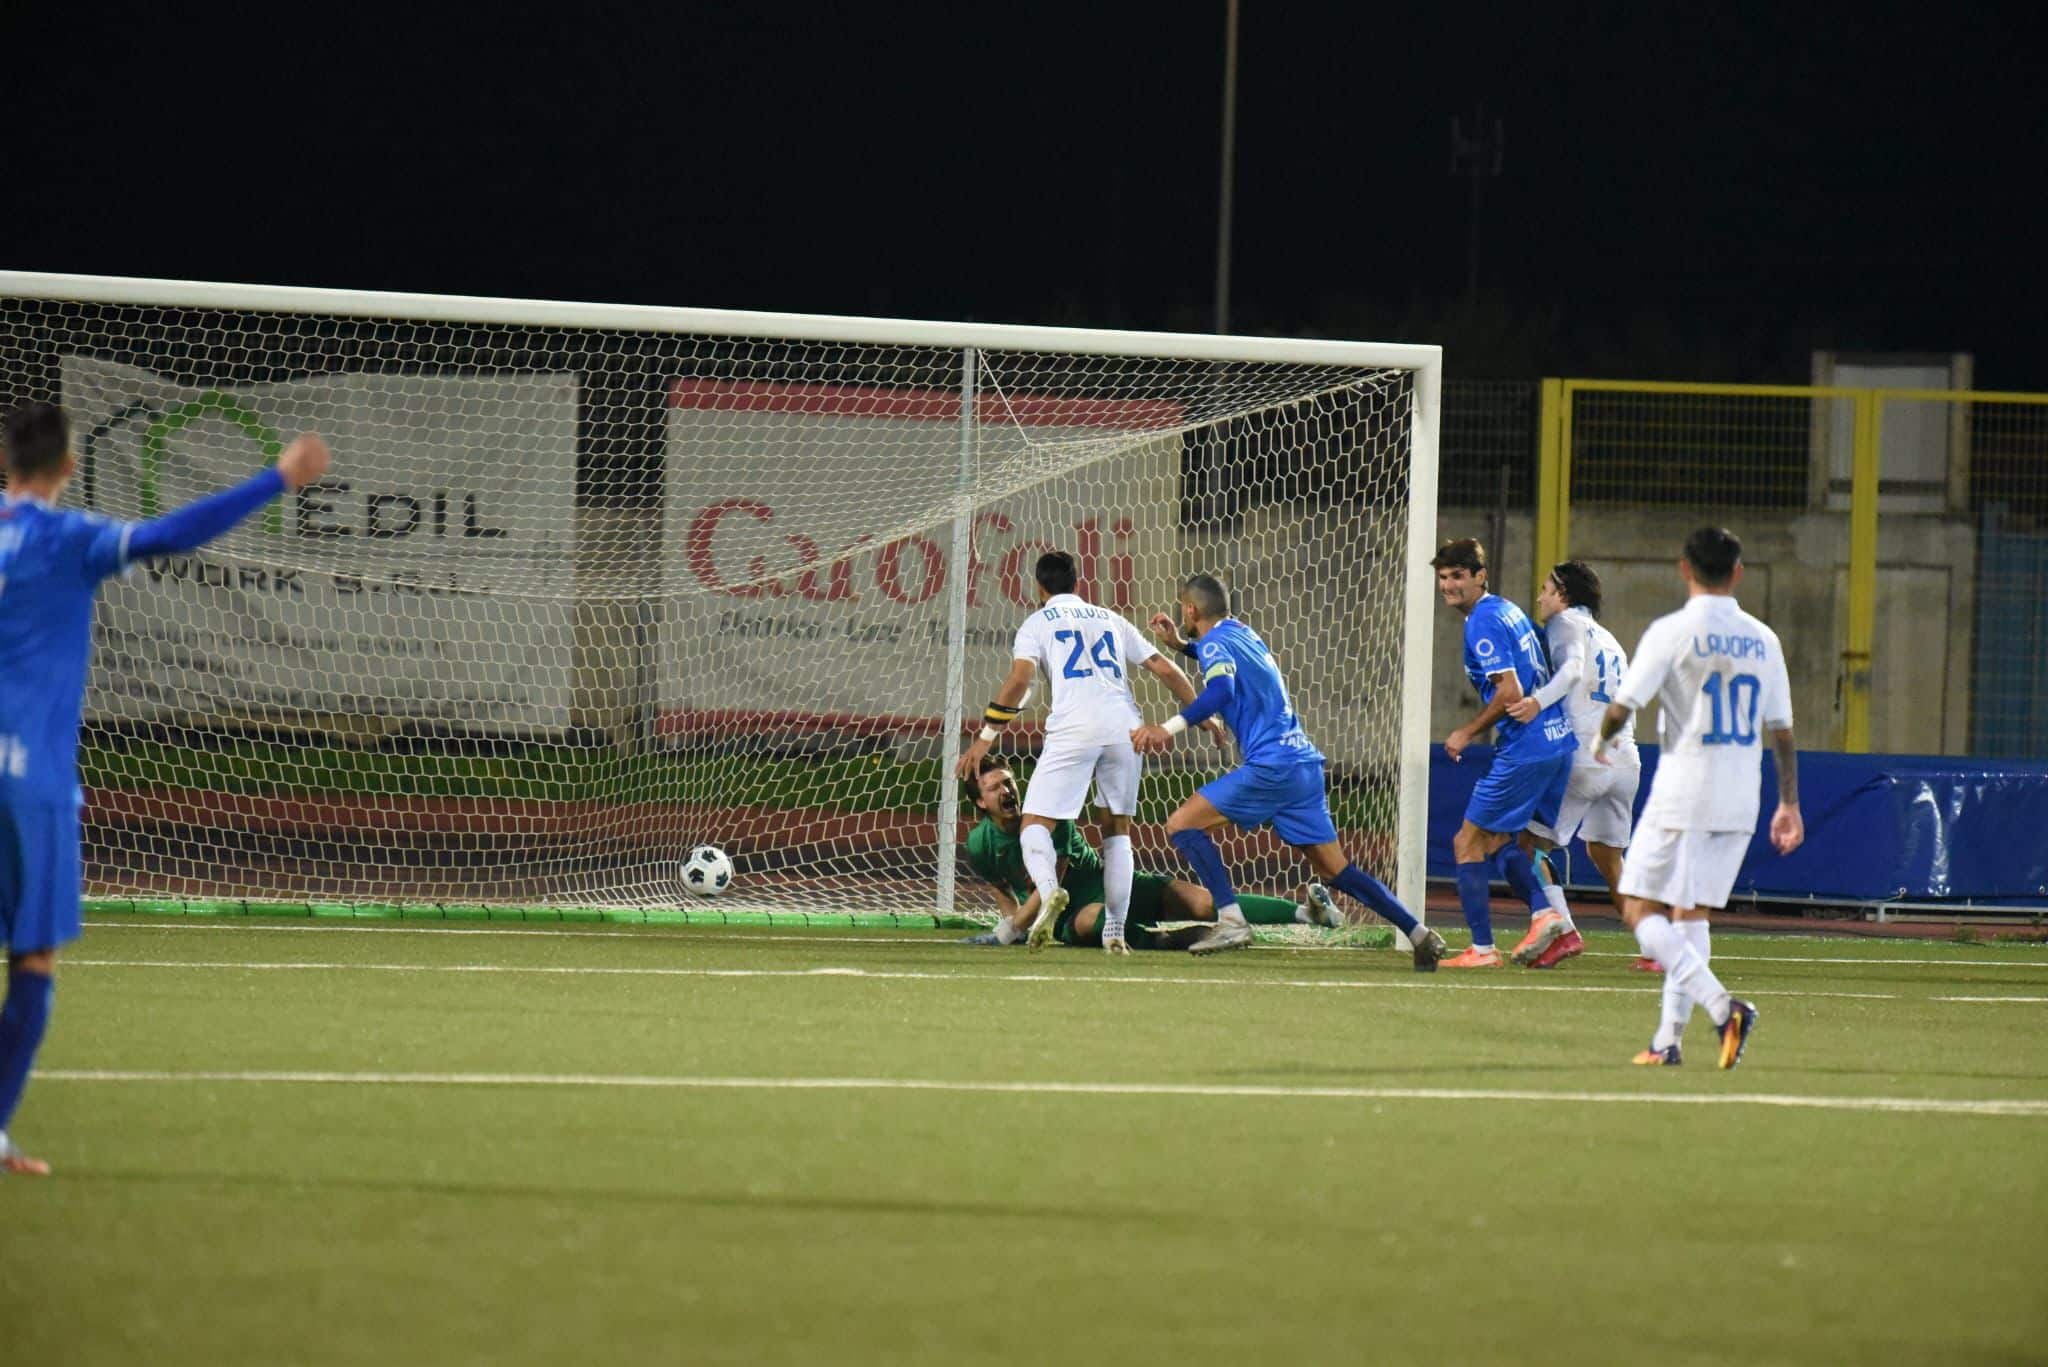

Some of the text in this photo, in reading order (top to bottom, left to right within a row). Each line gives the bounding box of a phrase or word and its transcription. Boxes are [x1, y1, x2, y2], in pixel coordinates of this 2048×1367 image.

[296, 483, 507, 538] EDIL
[147, 556, 304, 594] WORK
[1055, 630, 1122, 680] 24
[1702, 672, 1760, 746] 10
